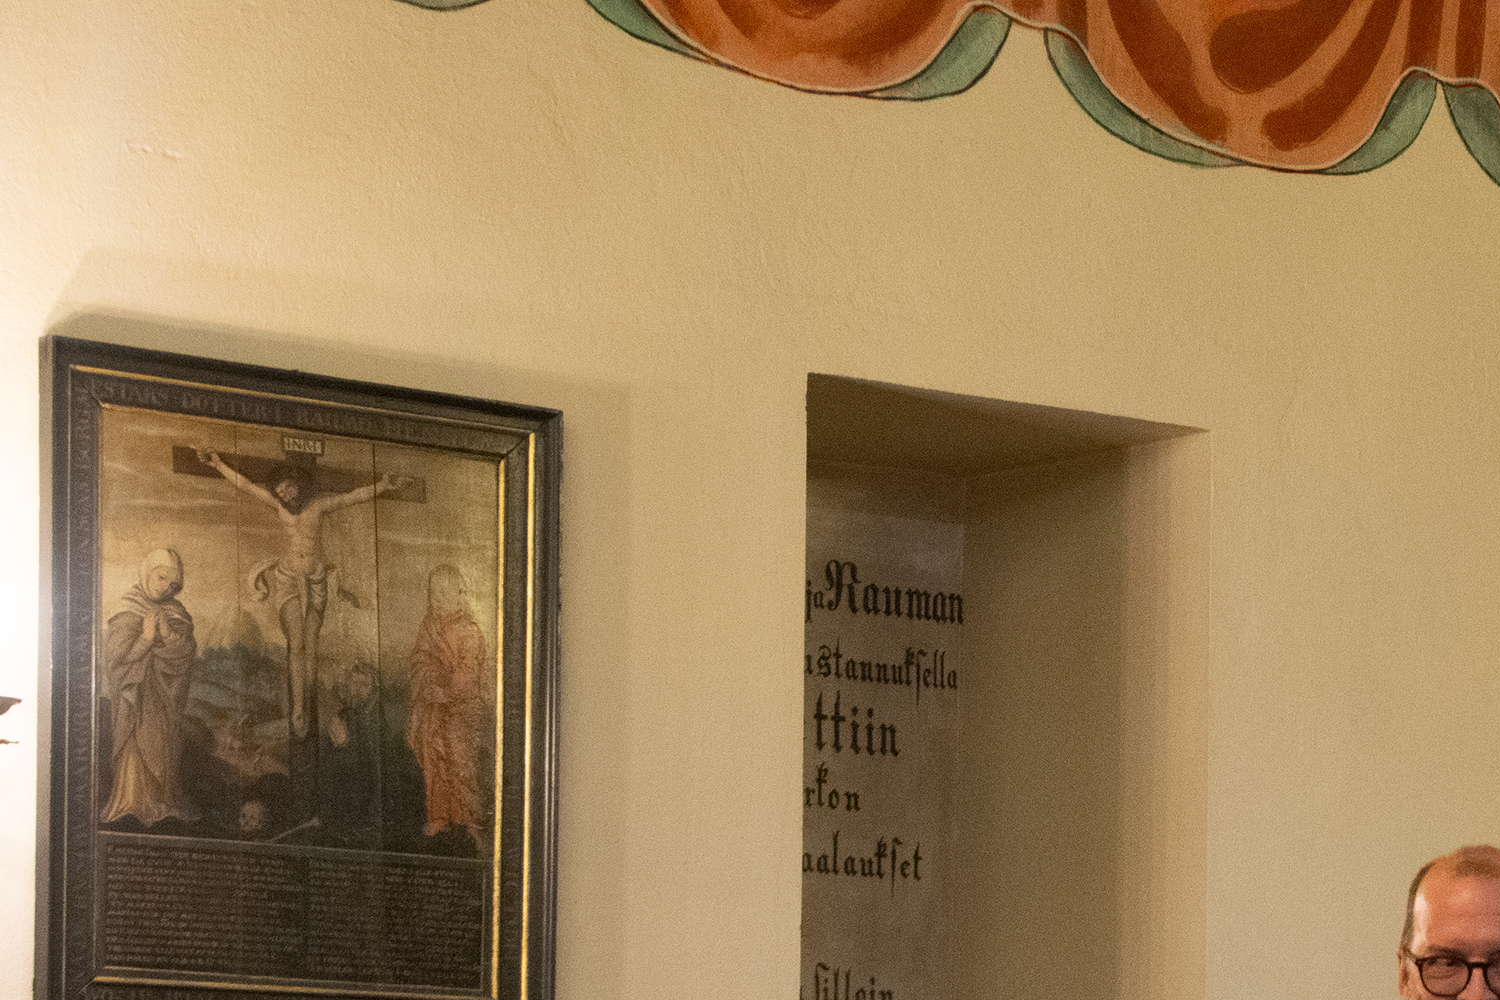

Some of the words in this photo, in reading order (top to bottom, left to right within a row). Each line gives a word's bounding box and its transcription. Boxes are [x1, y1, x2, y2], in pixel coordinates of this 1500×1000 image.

[804, 578, 825, 623] ja
[824, 559, 964, 625] Rauman
[803, 690, 901, 757] ttiin
